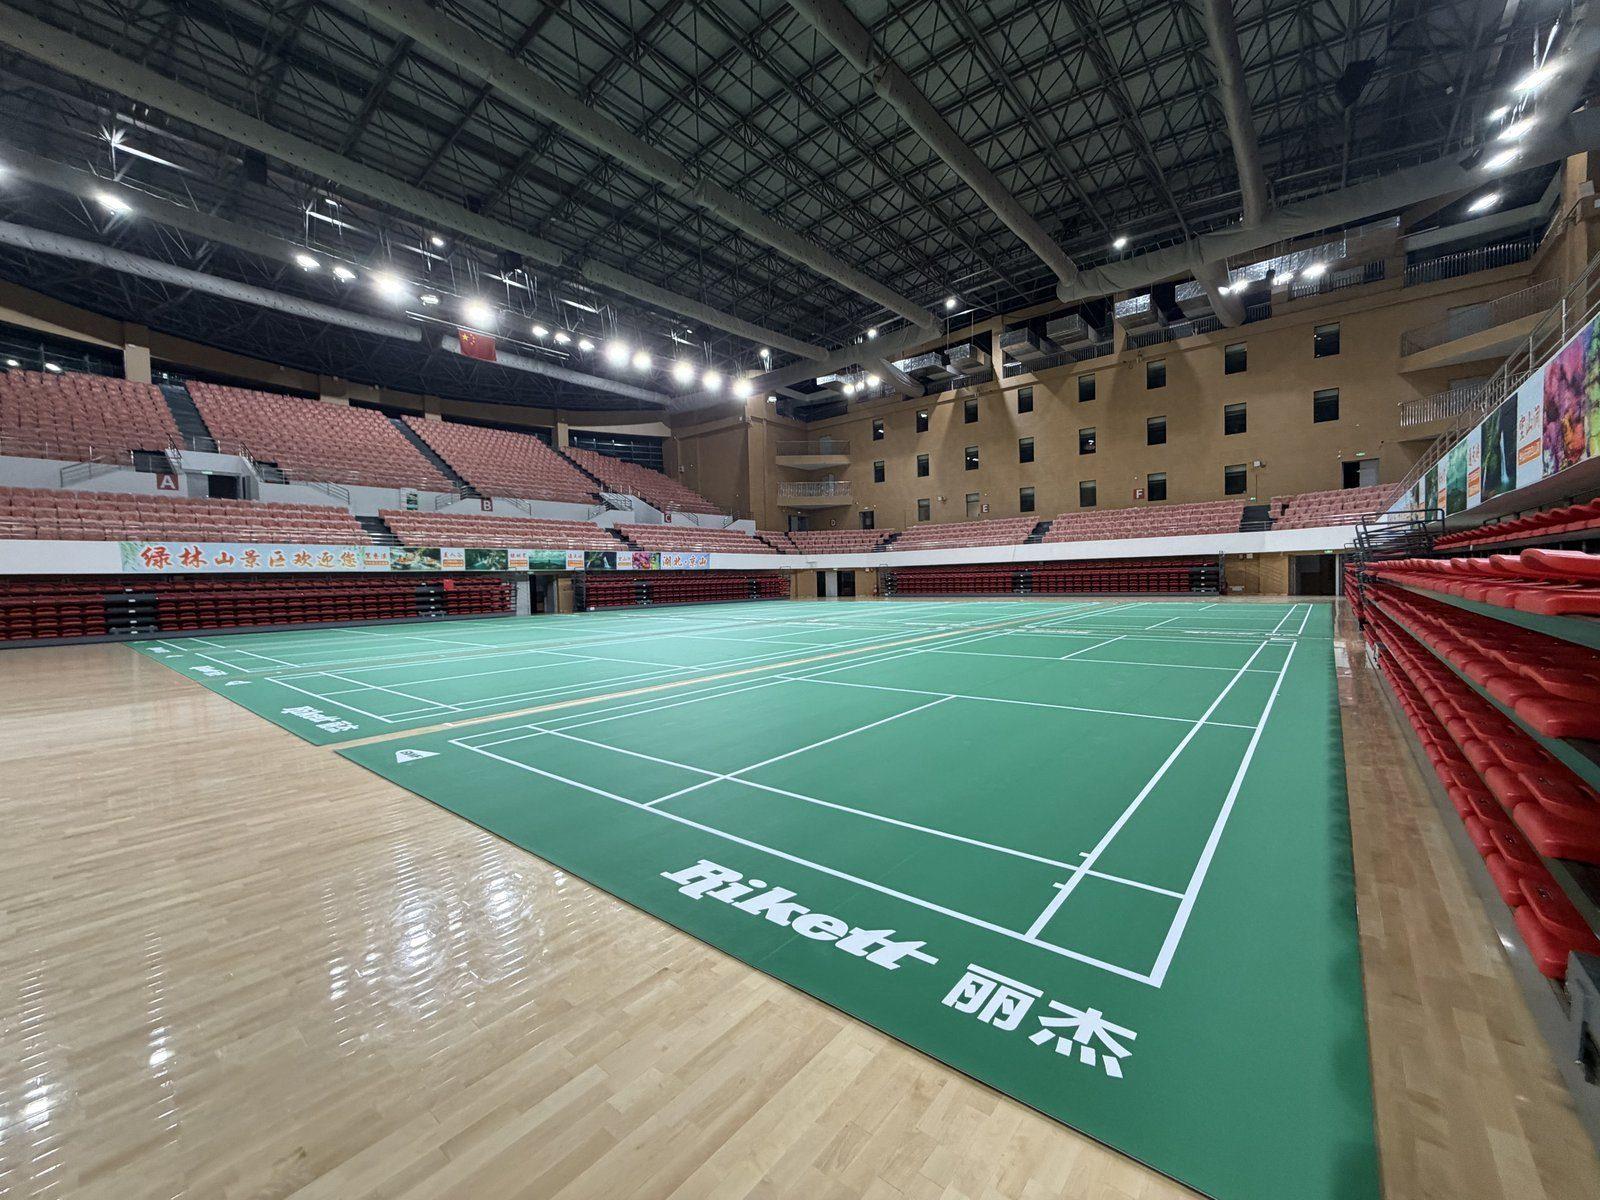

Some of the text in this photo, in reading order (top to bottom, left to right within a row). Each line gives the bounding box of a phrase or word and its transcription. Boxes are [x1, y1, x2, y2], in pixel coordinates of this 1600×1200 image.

[160, 474, 176, 489] A
[140, 545, 357, 570] 绿林山景区欢迎您
[660, 859, 1138, 1079] Rikett 丽杰
